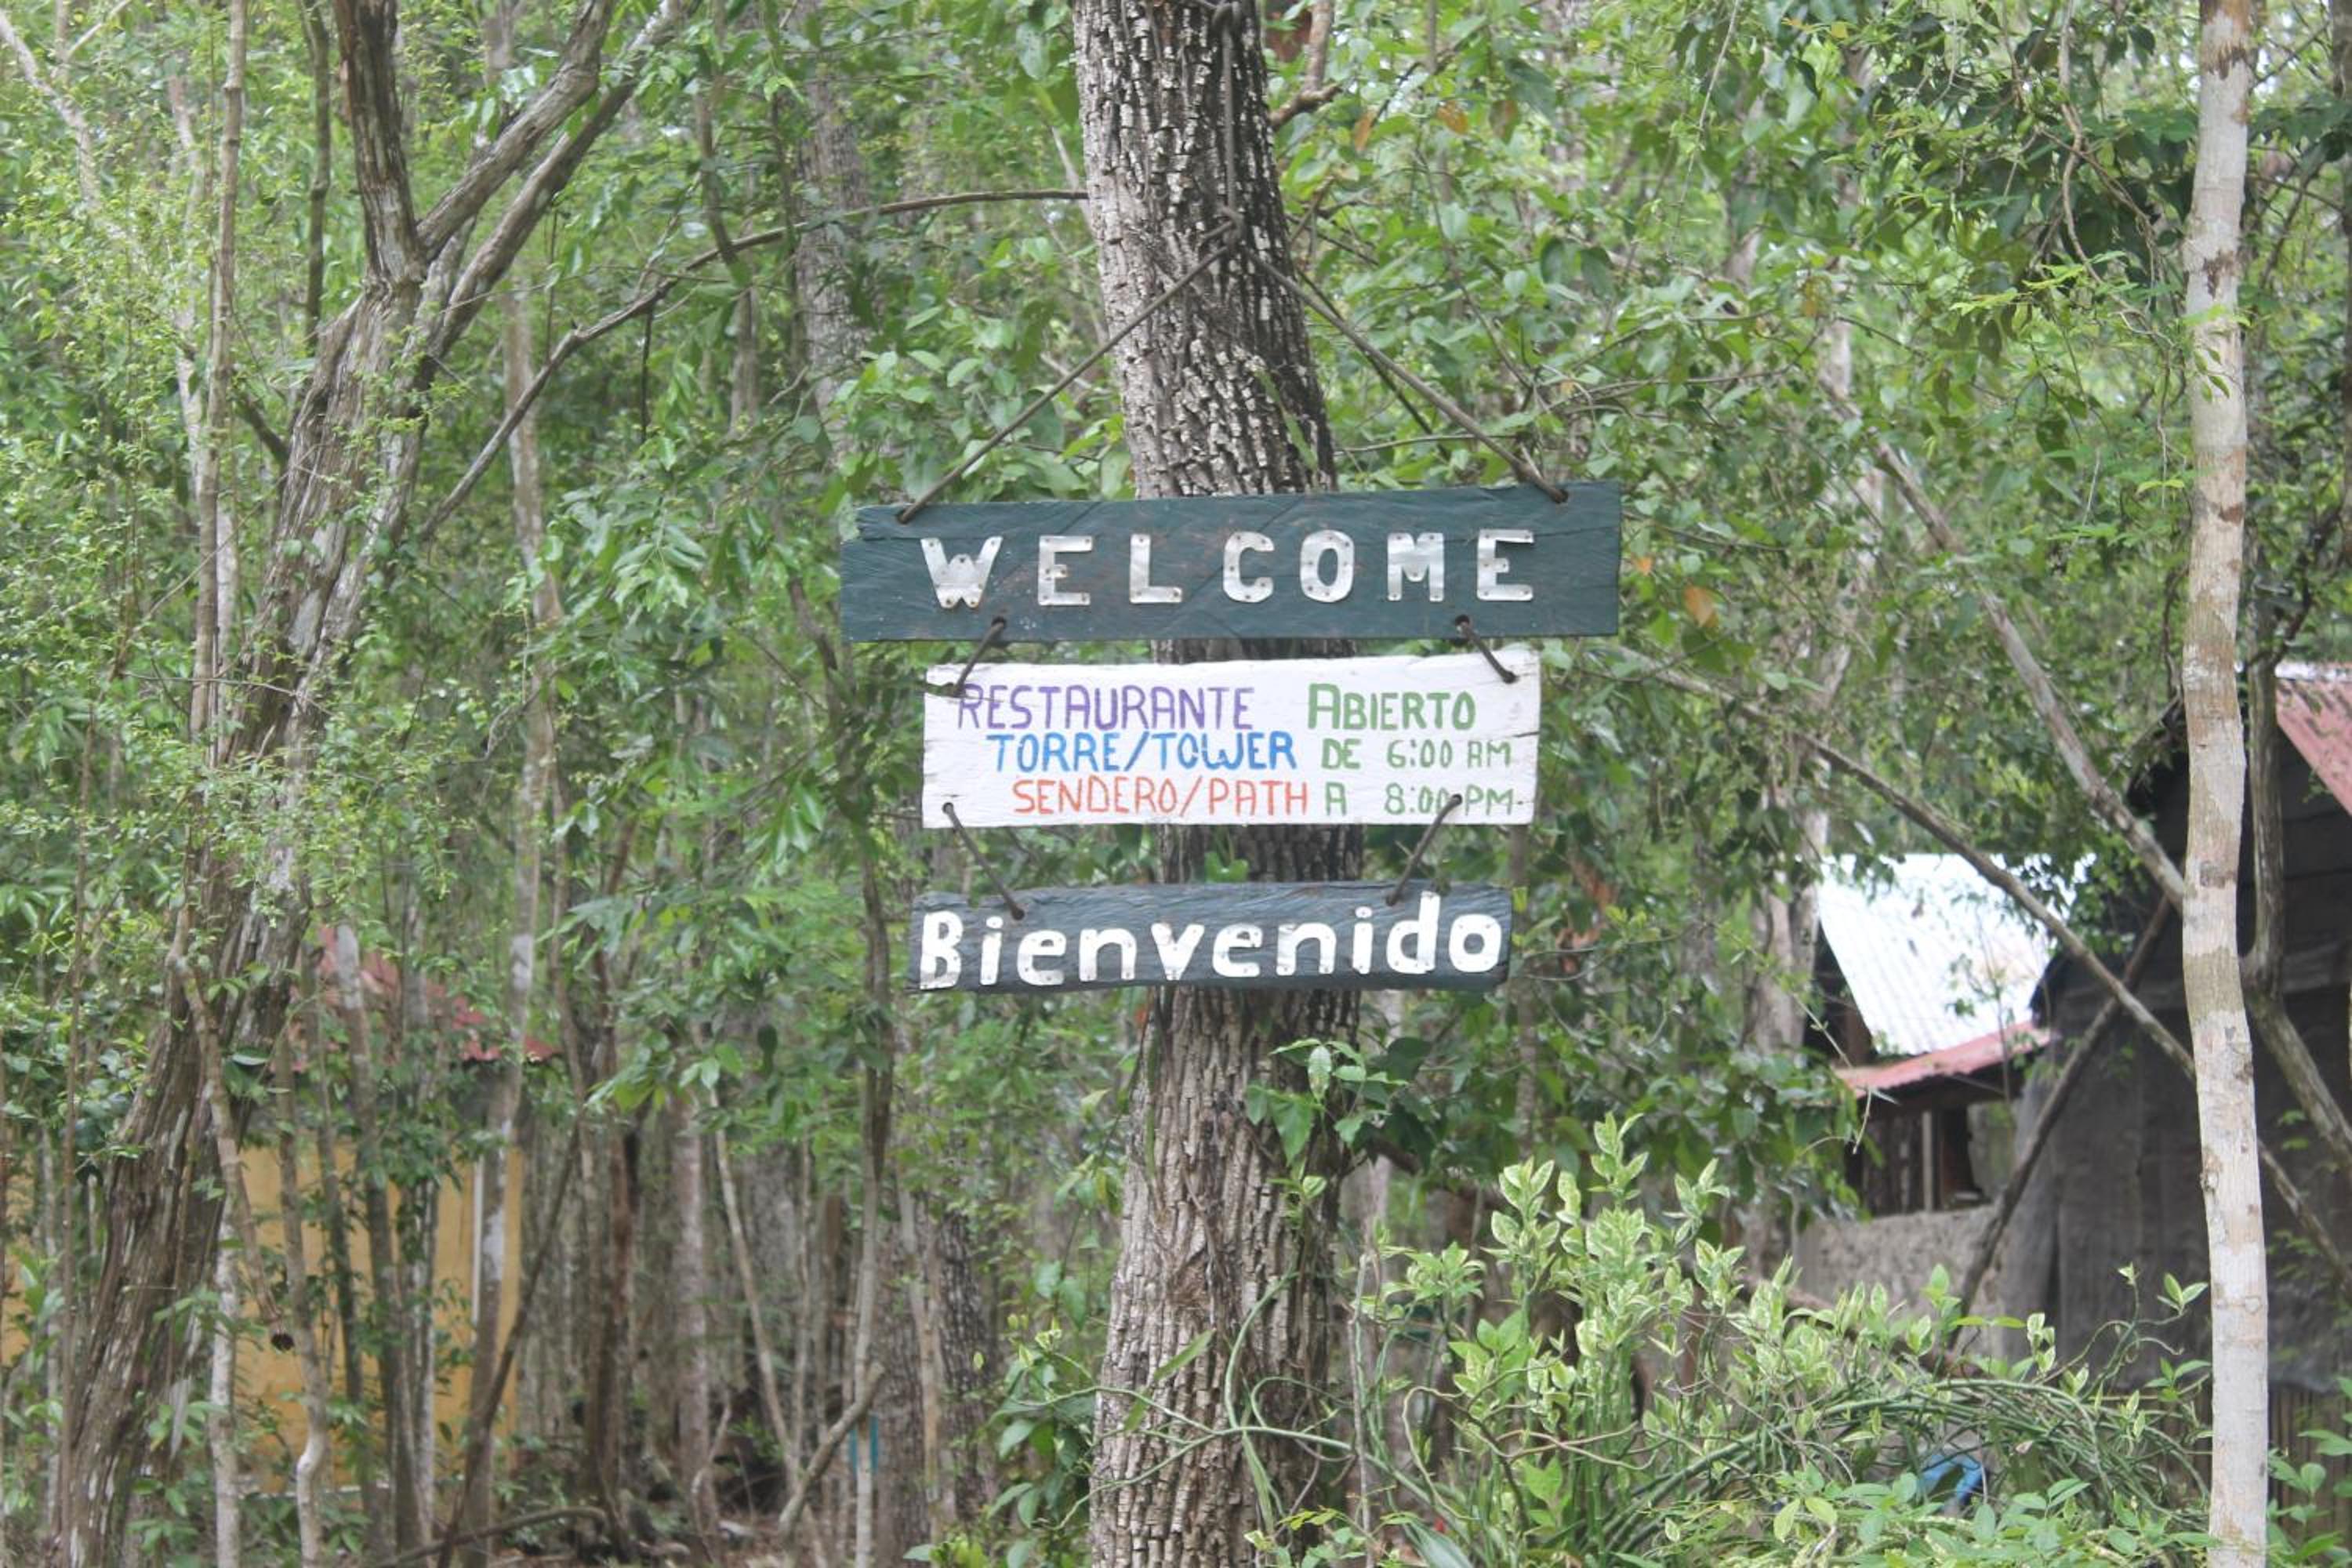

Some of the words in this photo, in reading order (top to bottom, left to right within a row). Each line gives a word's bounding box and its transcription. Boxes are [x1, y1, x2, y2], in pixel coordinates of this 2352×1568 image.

[920, 529, 1534, 610] WELCOME
[957, 683, 1254, 731] RESTAURANTE
[1308, 683, 1475, 730] ABIERTO
[985, 730, 1298, 772] TORRE/TOWER
[1321, 738, 1361, 769] DE
[1386, 739, 1454, 768] 6:00
[1467, 740, 1512, 768] AM
[1011, 774, 1308, 817] SENDERO/PATH
[1325, 782, 1347, 816] A
[1465, 785, 1514, 816] PM
[919, 891, 1503, 991] Bienvenido
